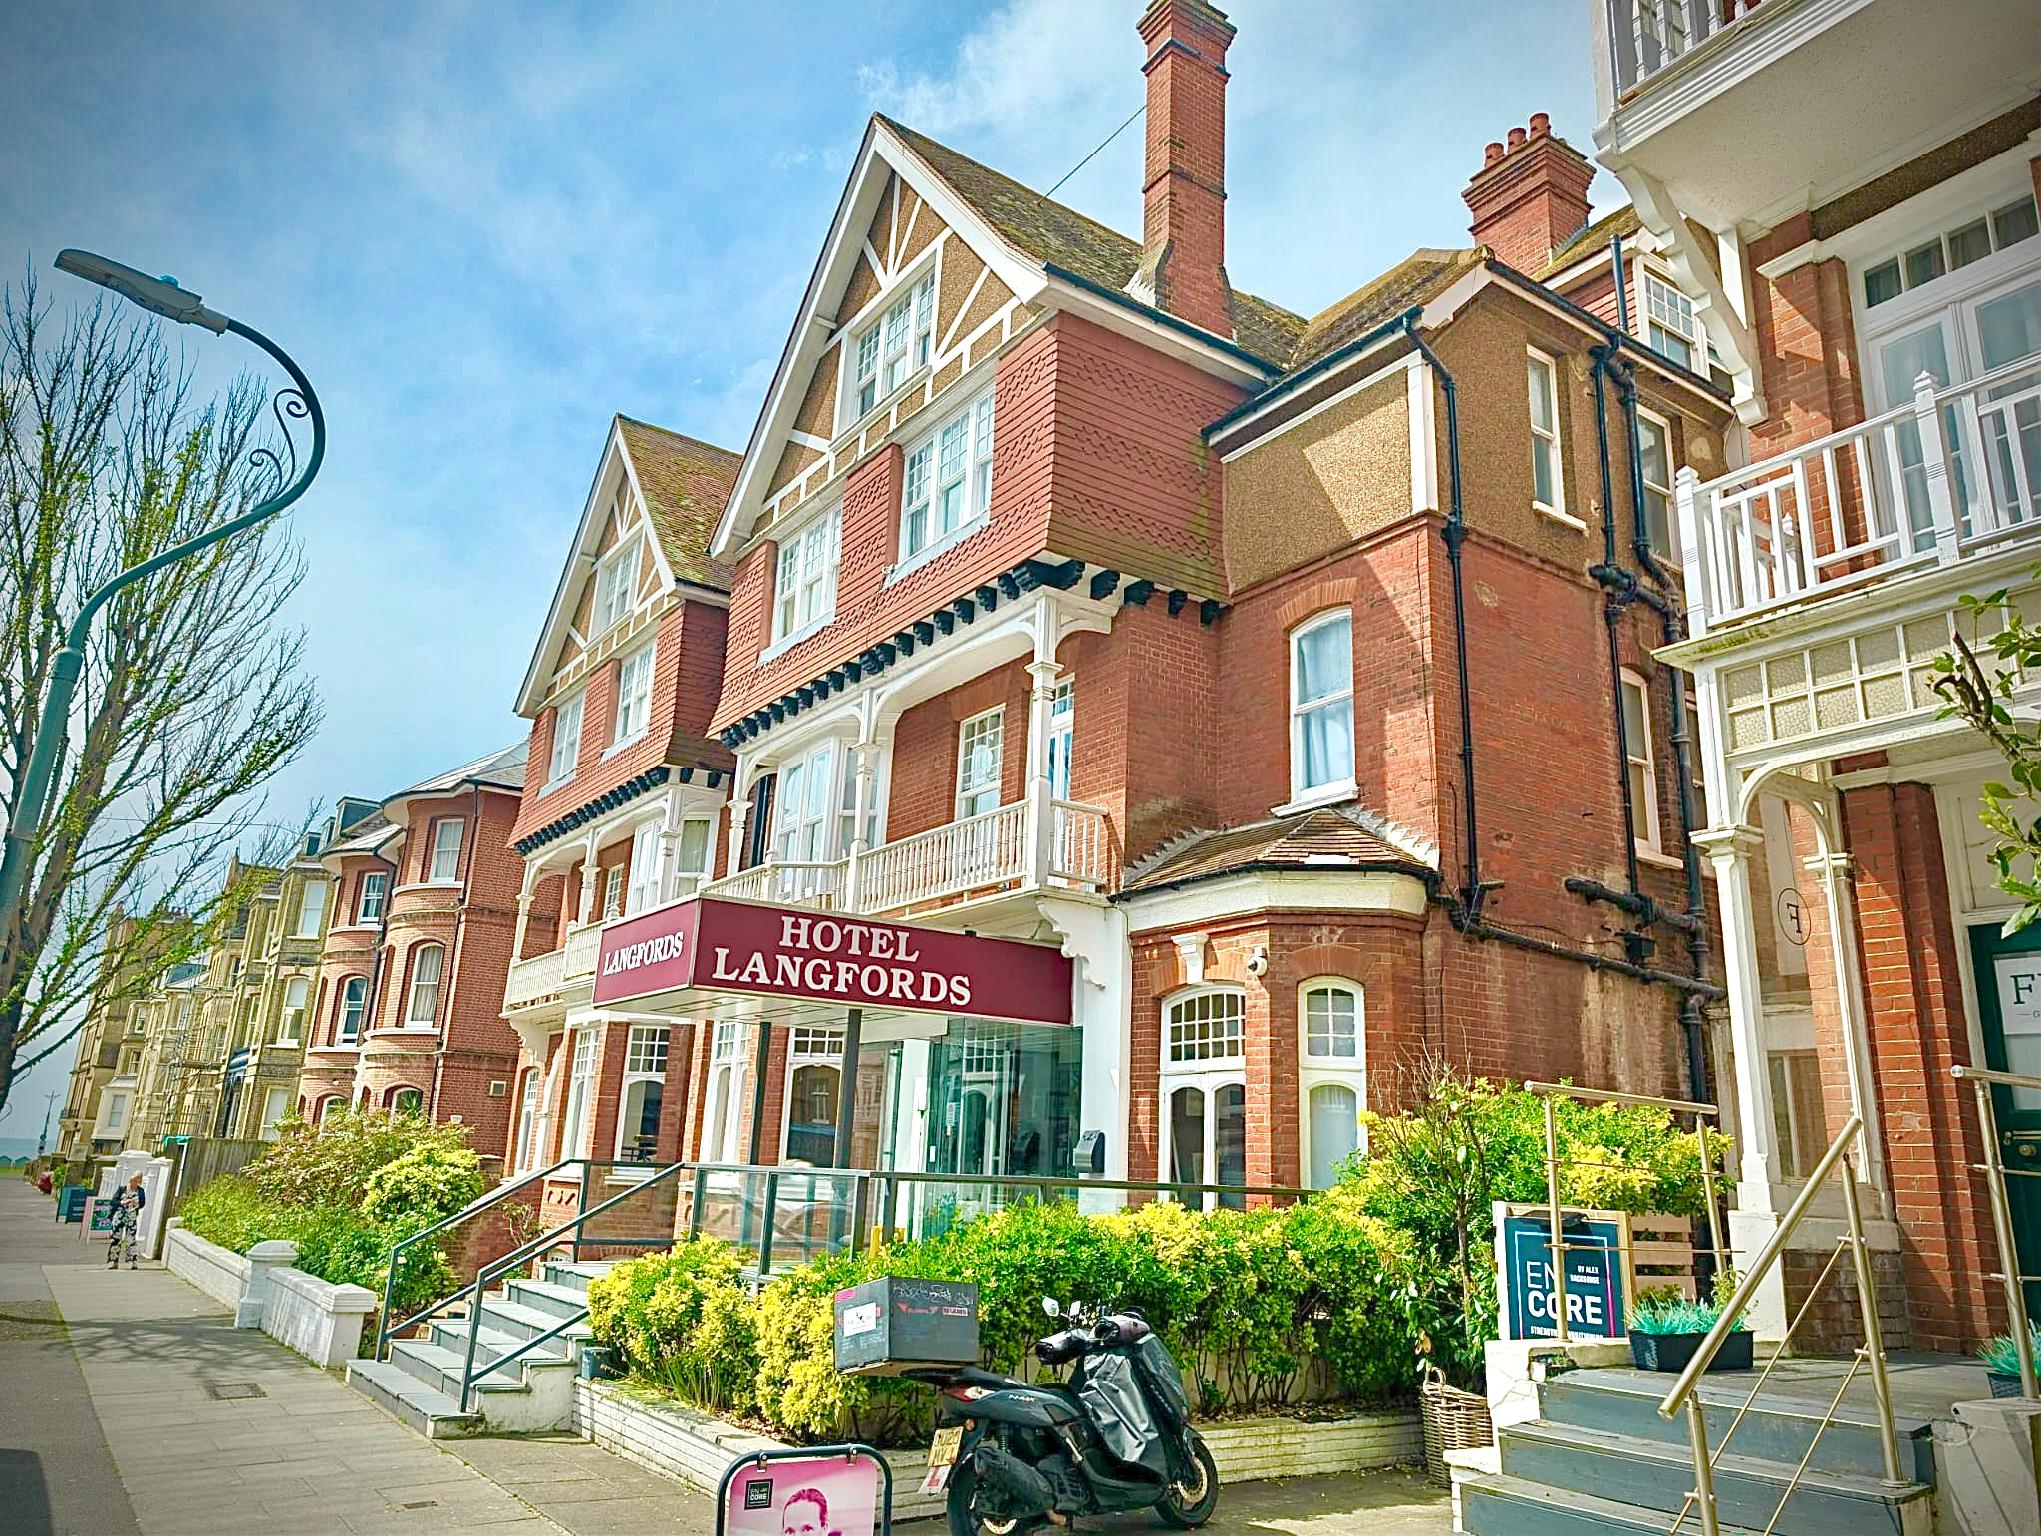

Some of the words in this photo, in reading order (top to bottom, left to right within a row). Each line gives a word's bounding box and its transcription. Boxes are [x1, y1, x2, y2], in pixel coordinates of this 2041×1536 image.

[602, 930, 684, 977] LANGFORDS
[779, 915, 920, 963] HOTEL
[711, 947, 972, 1006] LANGFORDS
[2009, 973, 2041, 1005] F
[1527, 1261, 1555, 1289] EN
[1528, 1289, 1603, 1325] CORE
